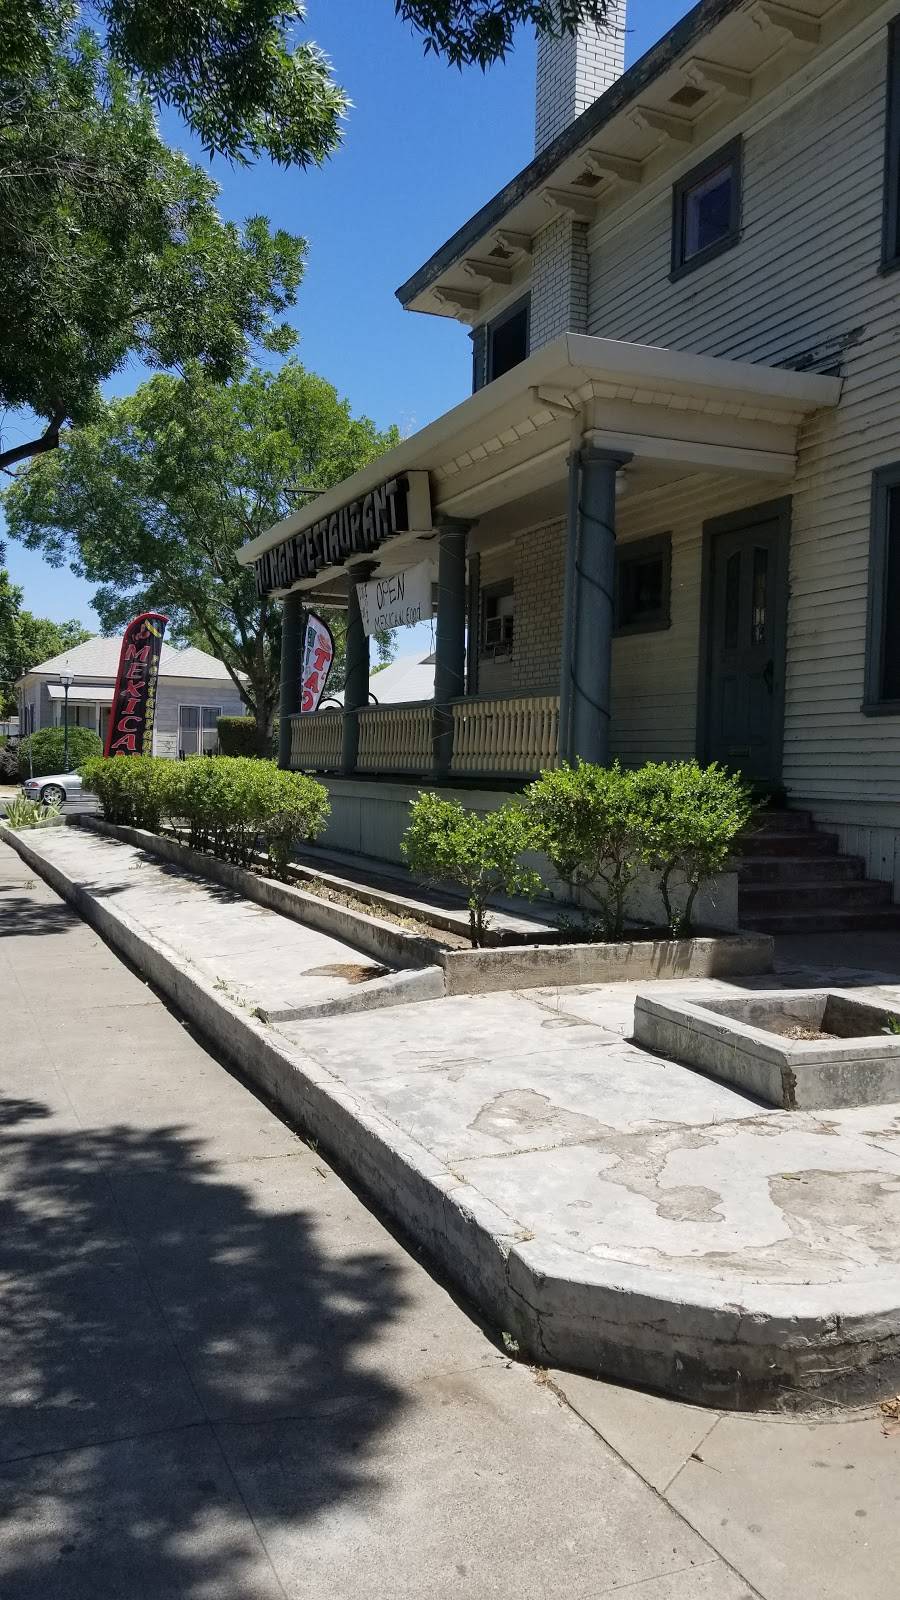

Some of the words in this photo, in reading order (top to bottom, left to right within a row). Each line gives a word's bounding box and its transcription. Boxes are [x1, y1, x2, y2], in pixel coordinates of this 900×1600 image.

[254, 538, 296, 597] HUNAN
[296, 479, 398, 577] RESTAURANT
[374, 609, 405, 632] MEXICAN
[376, 573, 405, 610] OPEN
[111, 643, 152, 757] MEXICA
